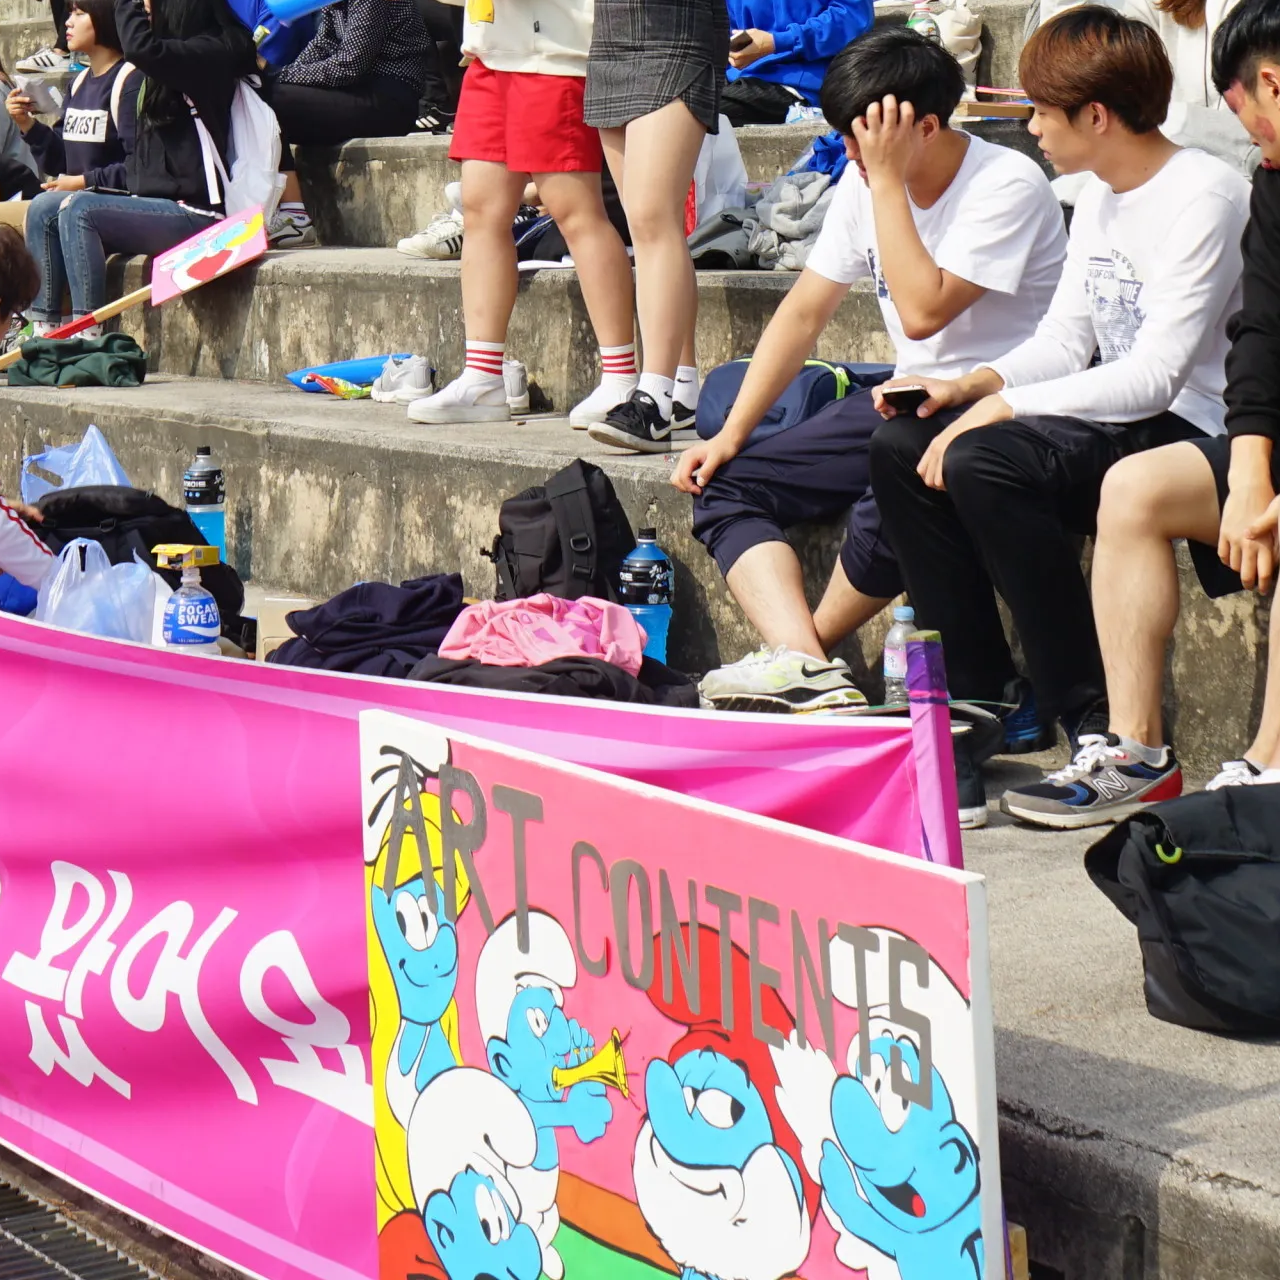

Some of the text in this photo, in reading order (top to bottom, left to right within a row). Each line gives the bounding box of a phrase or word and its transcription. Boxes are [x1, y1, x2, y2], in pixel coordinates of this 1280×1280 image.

[177, 612, 218, 625] SWEAT
[2, 859, 375, 1128] 왔어요
[383, 752, 933, 1111] ART CONTENTS
